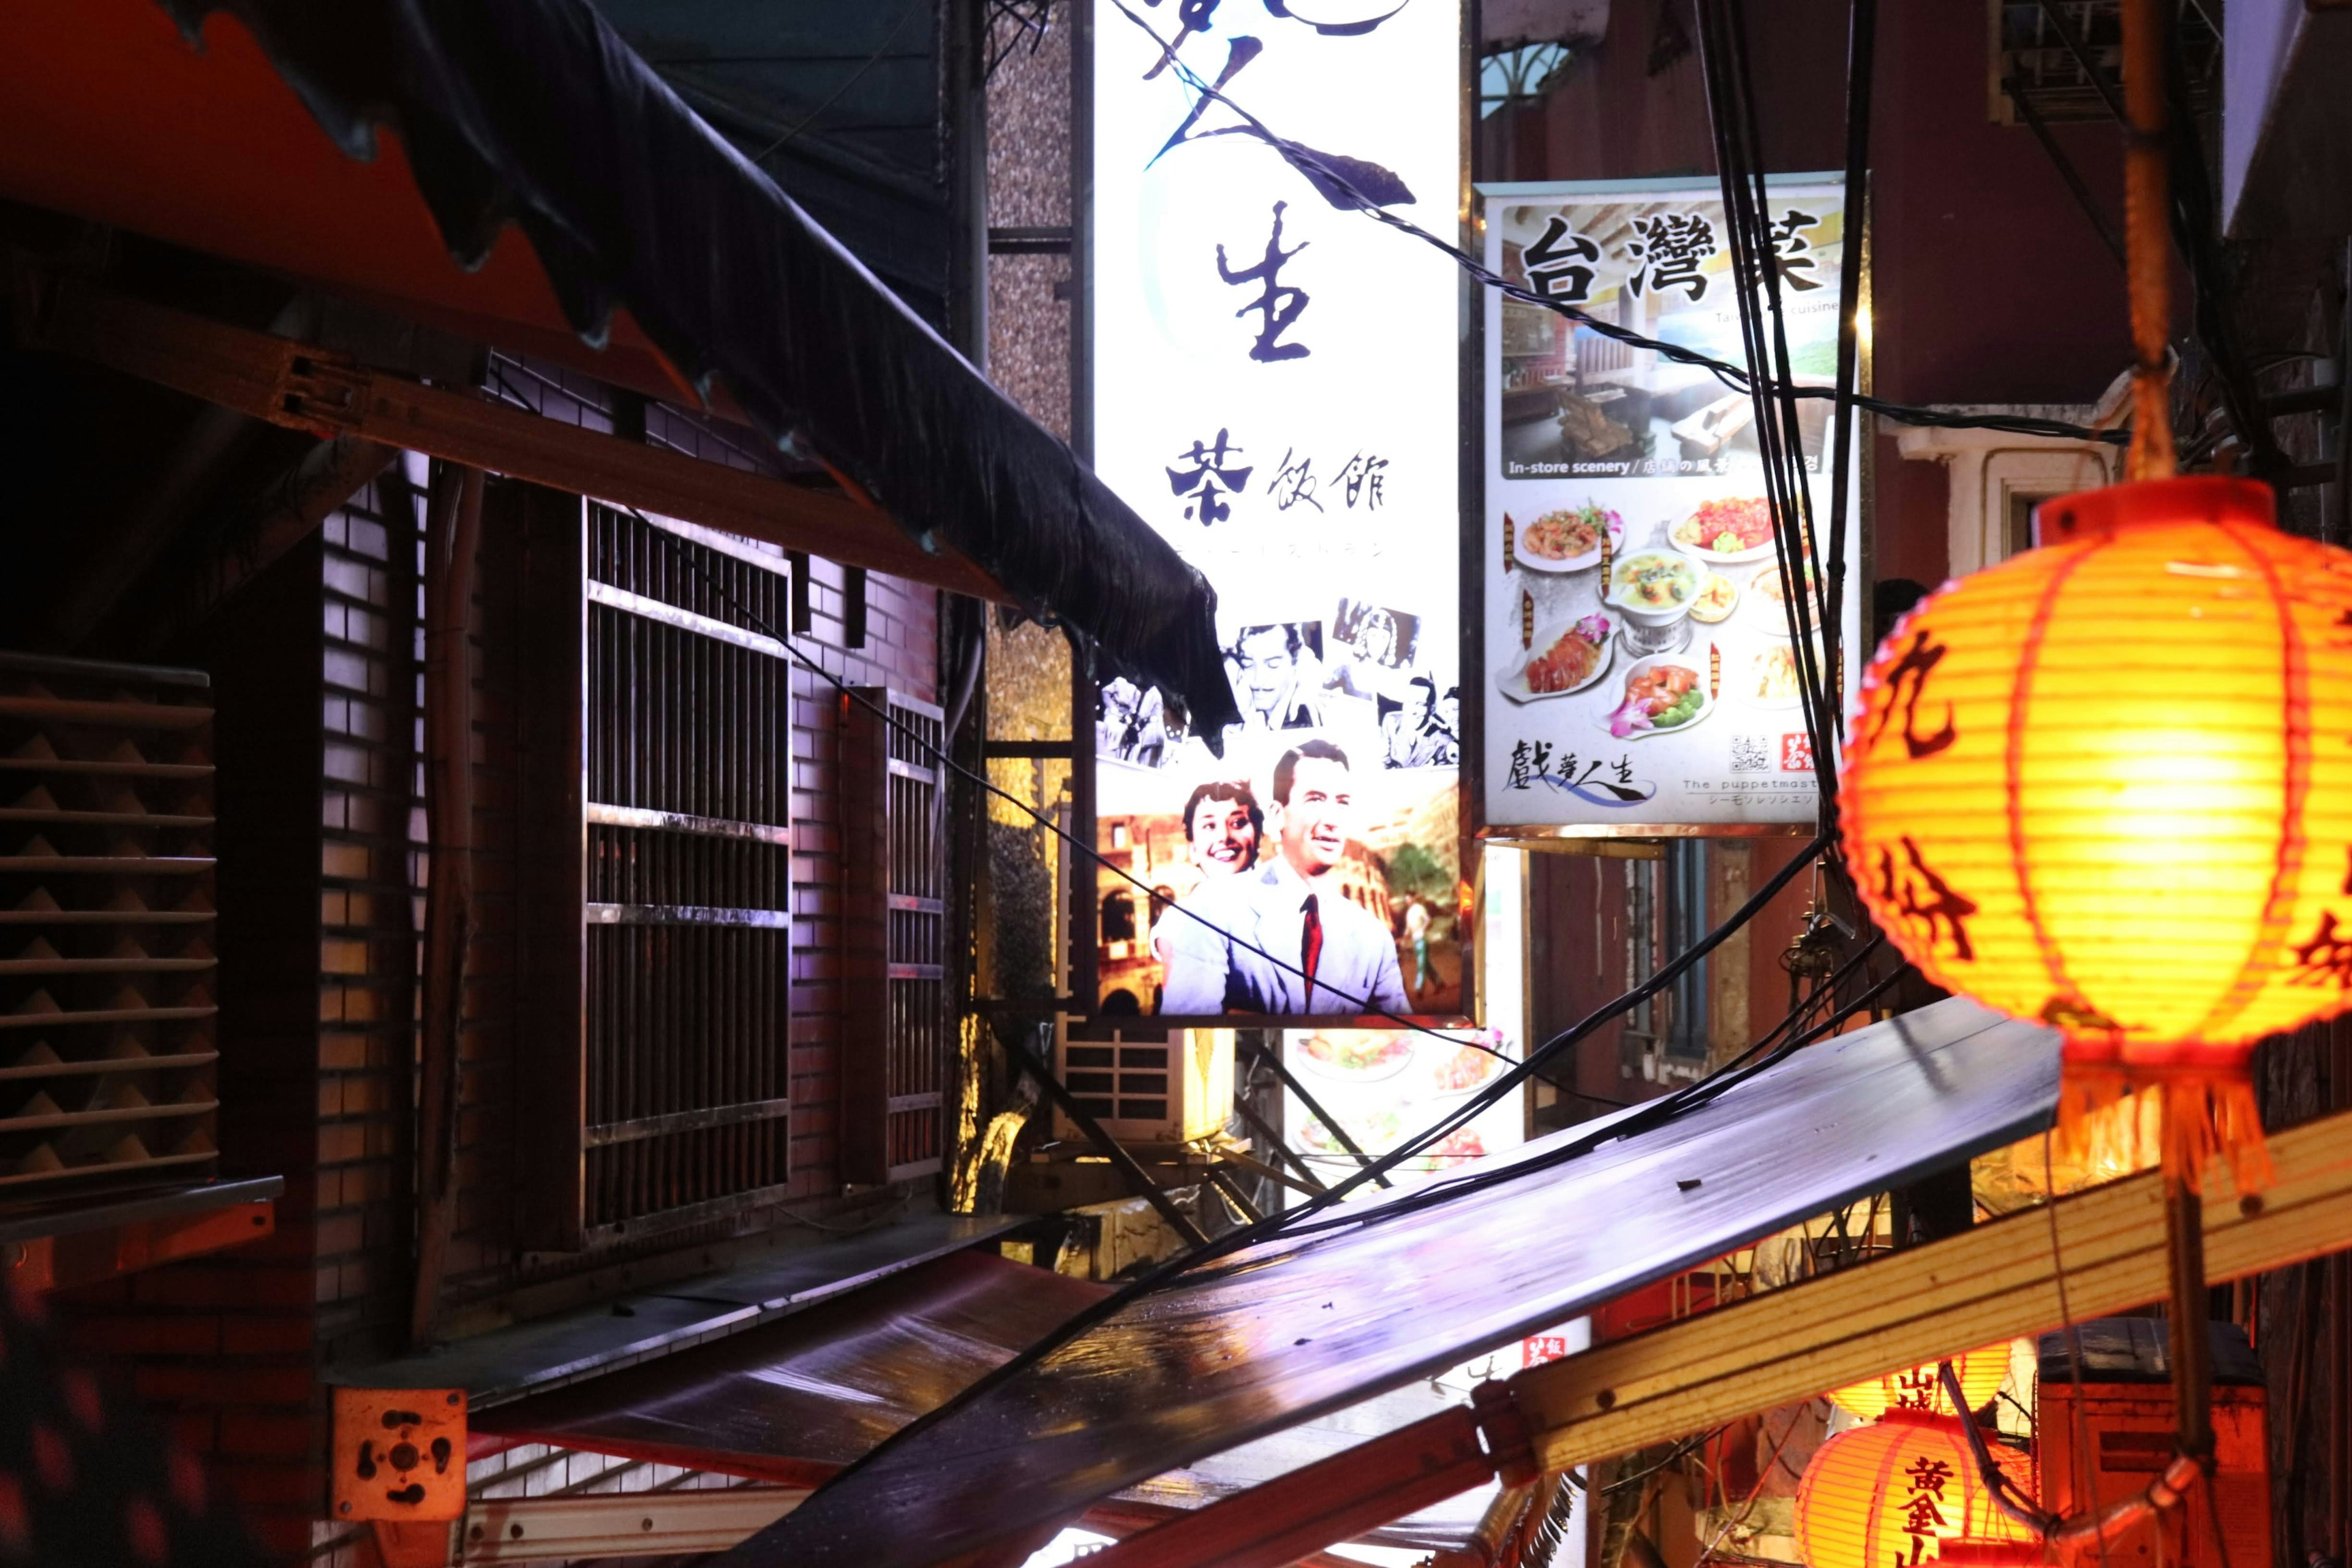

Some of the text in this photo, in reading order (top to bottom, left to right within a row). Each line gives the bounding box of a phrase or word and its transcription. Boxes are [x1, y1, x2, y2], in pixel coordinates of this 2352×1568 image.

[1524, 211, 1824, 301] 台灣菜
[1791, 302, 1839, 315] cuisine
[1509, 461, 1569, 474] In-store
[1572, 461, 1630, 475] scenery
[1683, 780, 1819, 790] The puppetmast
